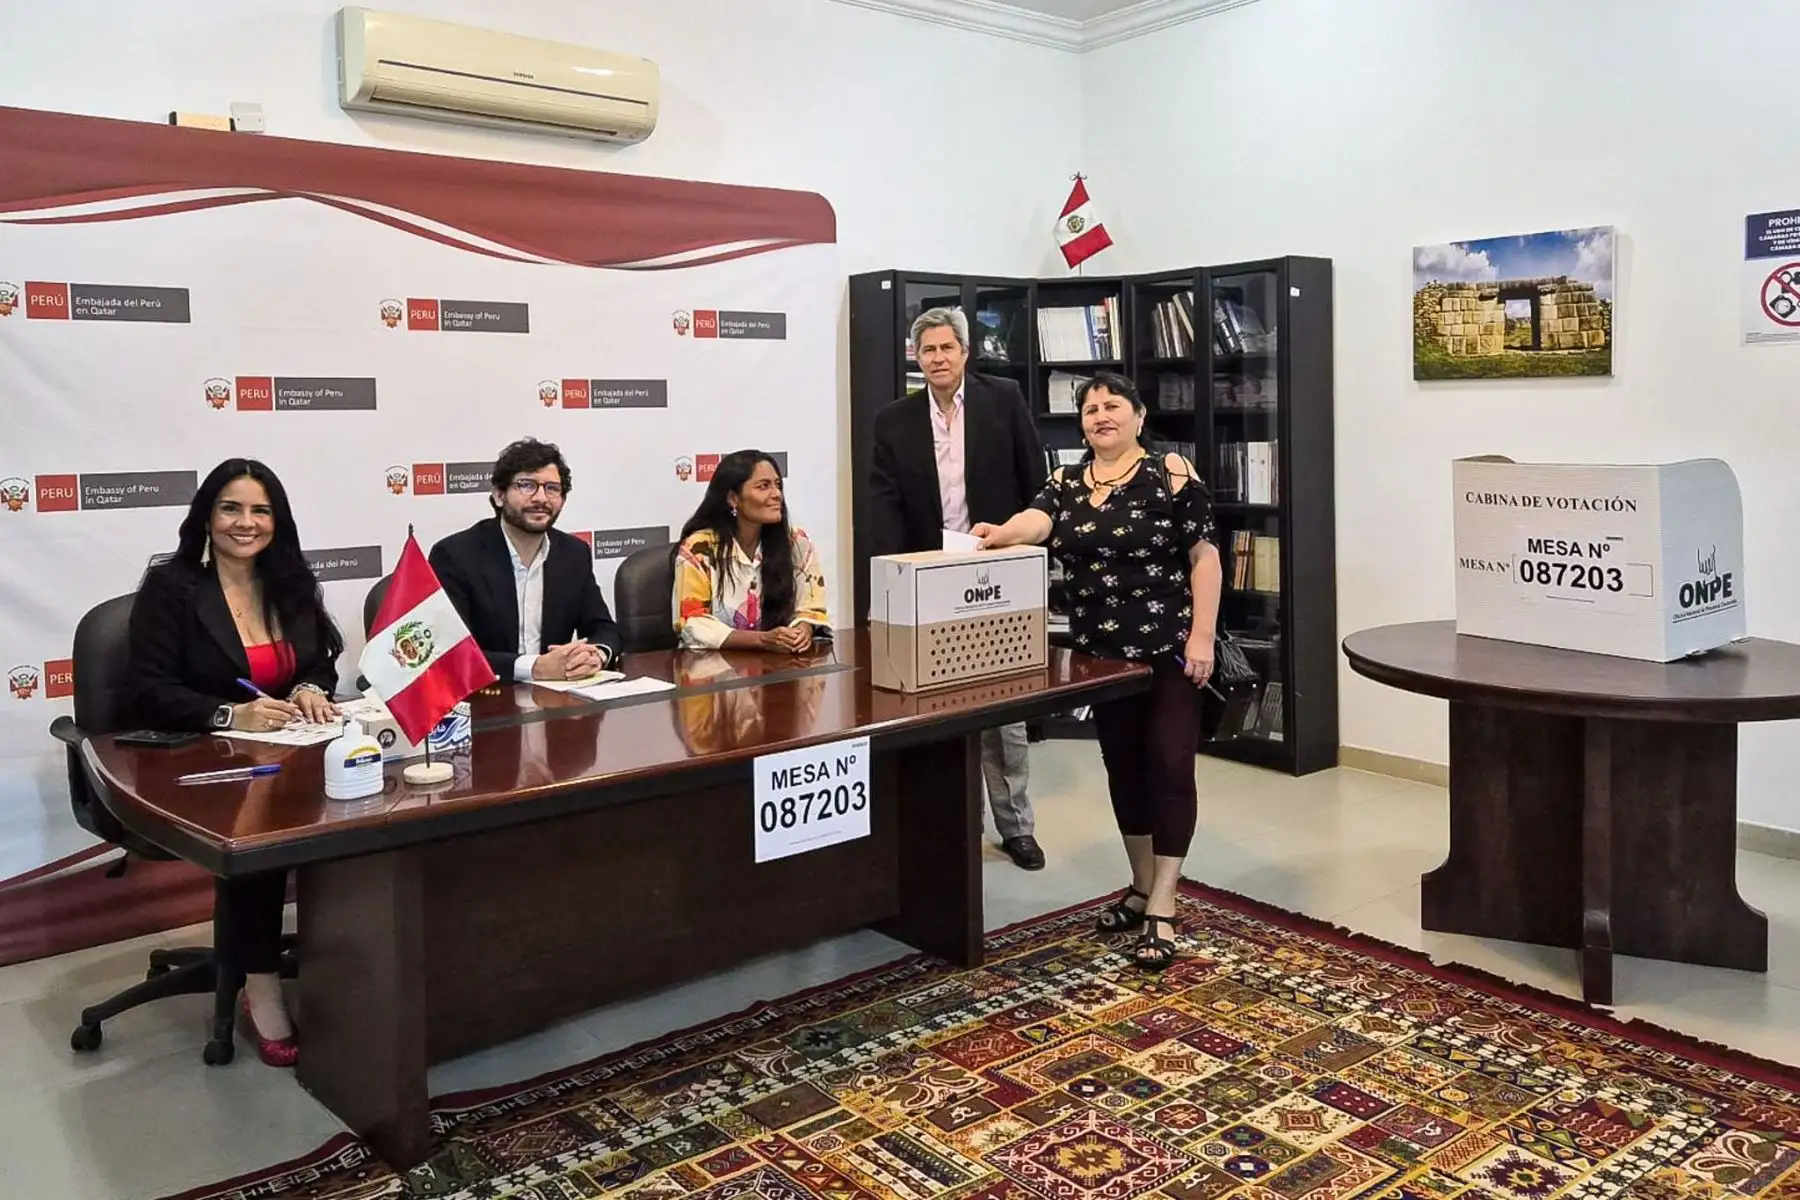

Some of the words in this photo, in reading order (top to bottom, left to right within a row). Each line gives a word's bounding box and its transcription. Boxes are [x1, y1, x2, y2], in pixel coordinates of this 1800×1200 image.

[30, 293, 64, 306] PERÚ
[75, 296, 122, 308] Embajada
[124, 297, 138, 307] del
[140, 298, 161, 308] Perú
[90, 307, 117, 316] Qatar
[410, 309, 436, 320] PERU
[444, 311, 474, 321] Embassy
[475, 311, 483, 320] of
[484, 312, 500, 320] Peru
[452, 319, 472, 327] Qatar
[696, 318, 715, 329] PERÚ
[240, 388, 269, 399] PERU
[278, 388, 313, 399] Embassy
[315, 388, 323, 397] of
[324, 388, 343, 397] Peru
[564, 388, 587, 399] PERÚ
[288, 398, 311, 406] Qatar
[416, 472, 441, 485] PERÚ
[449, 473, 483, 482] Embajada
[484, 472, 493, 480] de
[85, 486, 125, 496] Embassy
[126, 485, 137, 494] of
[138, 484, 159, 493] Peru
[459, 482, 479, 490] Qatar
[40, 487, 74, 499] PERU
[85, 496, 94, 505] in
[96, 495, 122, 504] Qatar
[1465, 491, 1518, 507] CABINA
[1522, 495, 1542, 508] DE
[1545, 496, 1637, 512] VOTACIÓN
[1527, 538, 1583, 557] MESA
[1459, 557, 1495, 572] MESA
[1519, 559, 1624, 592] 087203
[964, 585, 1001, 603] ONPE
[1679, 572, 1733, 609] ONPE
[50, 672, 73, 685] PER
[771, 761, 830, 791] MESA
[760, 781, 866, 833] 087203
